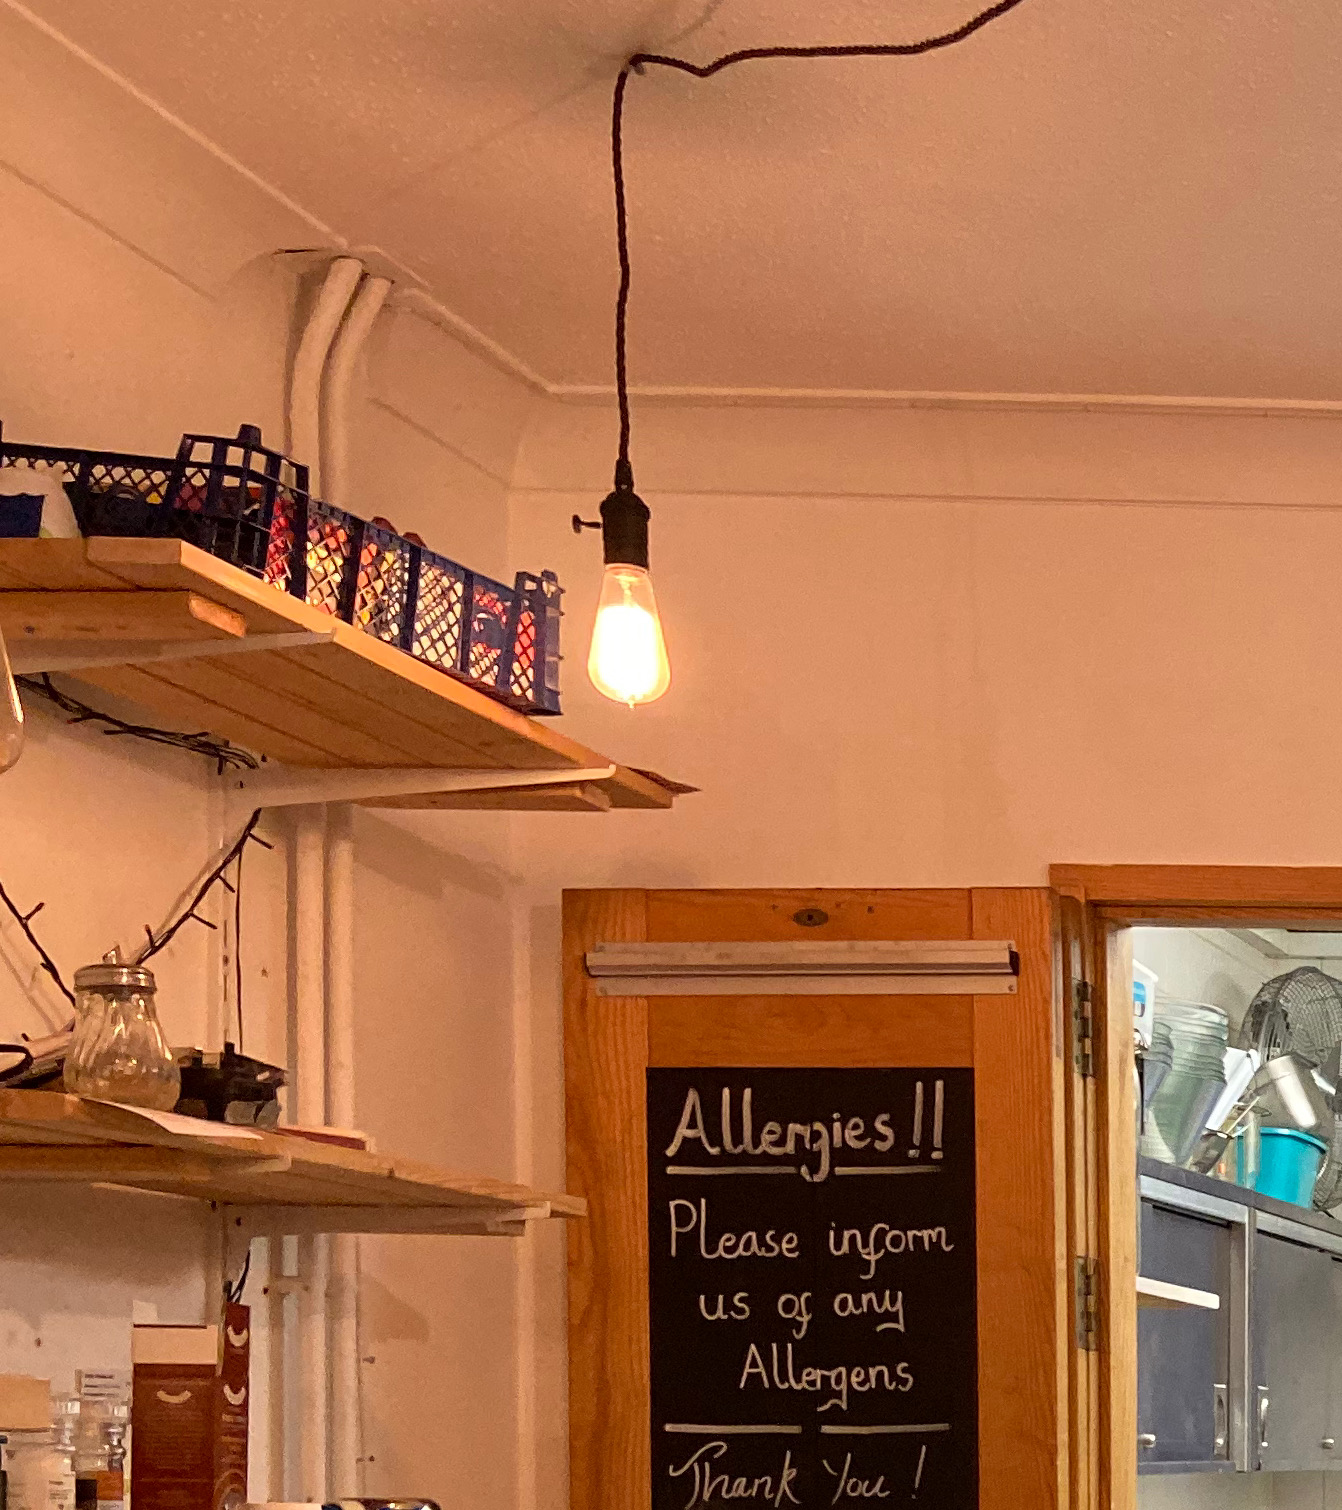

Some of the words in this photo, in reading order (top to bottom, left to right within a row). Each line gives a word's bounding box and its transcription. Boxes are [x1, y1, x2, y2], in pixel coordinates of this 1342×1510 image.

[668, 1198, 799, 1260] Please
[828, 1222, 954, 1279] inform
[699, 1290, 751, 1321] us
[777, 1291, 812, 1339] of
[833, 1291, 905, 1333] any
[739, 1342, 914, 1413] Allergens
[669, 1440, 800, 1510] Thank
[822, 1451, 890, 1505] You
